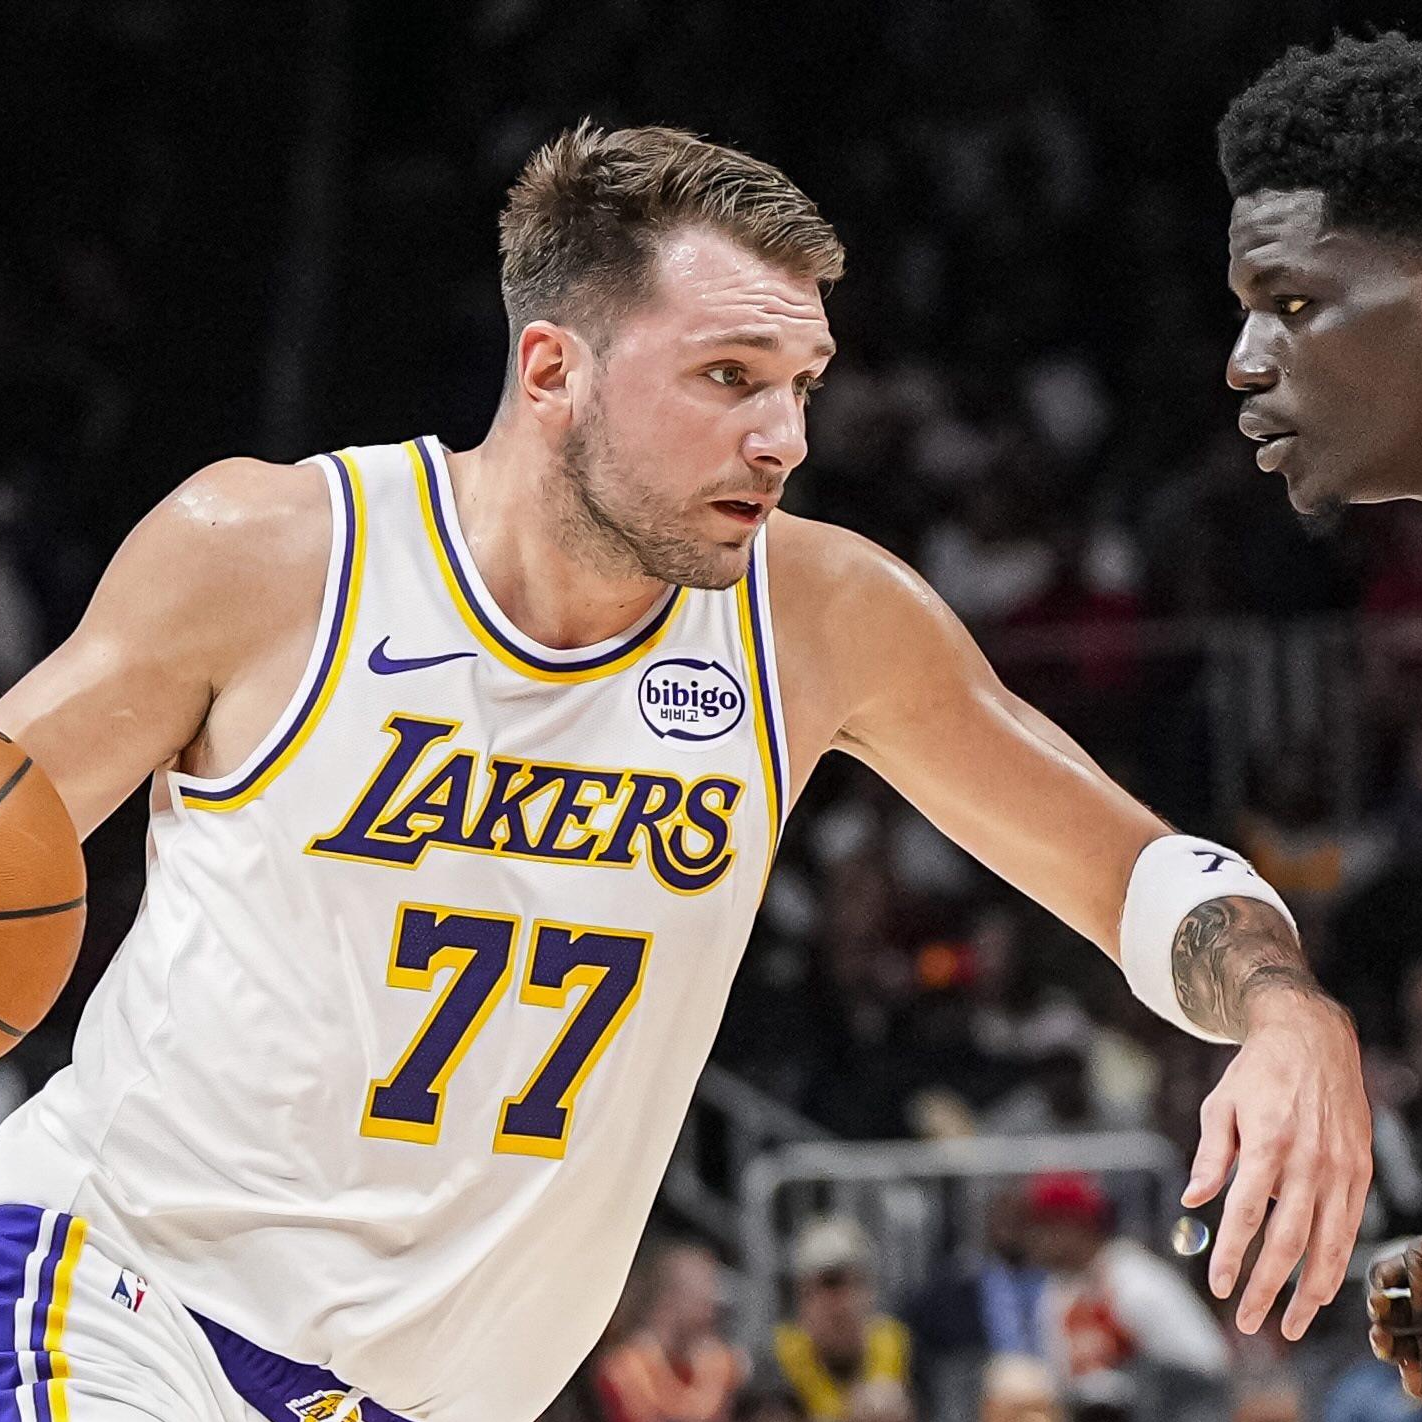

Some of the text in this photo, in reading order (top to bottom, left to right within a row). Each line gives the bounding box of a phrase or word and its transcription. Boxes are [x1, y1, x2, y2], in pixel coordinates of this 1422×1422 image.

[647, 679, 738, 718] bibigo
[660, 708, 700, 722] 비비고
[303, 711, 746, 896] LAKERS
[360, 900, 654, 1160] 77
